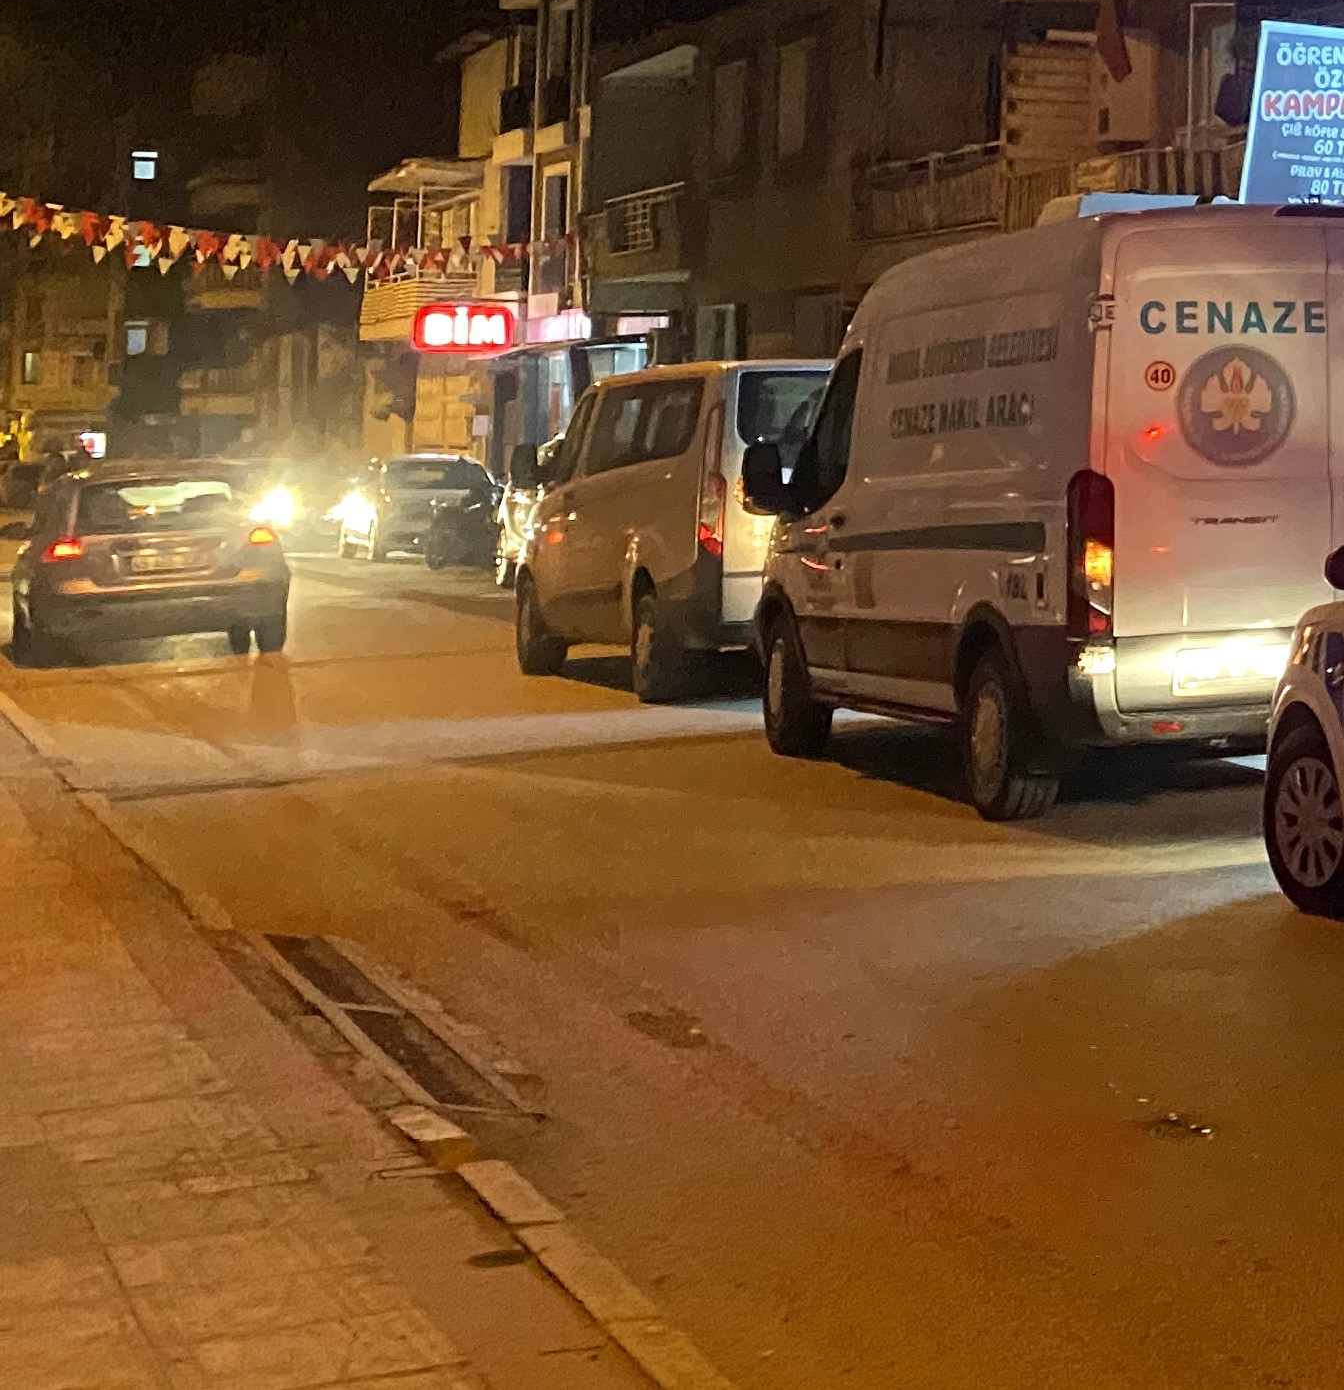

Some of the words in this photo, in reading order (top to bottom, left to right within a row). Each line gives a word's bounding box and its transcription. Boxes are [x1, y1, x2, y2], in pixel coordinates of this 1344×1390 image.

[1313, 139, 1334, 155] 60
[1310, 179, 1331, 196] 80
[424, 306, 506, 346] BİM
[1139, 299, 1327, 336] CENAZE
[1150, 368, 1171, 384] 40
